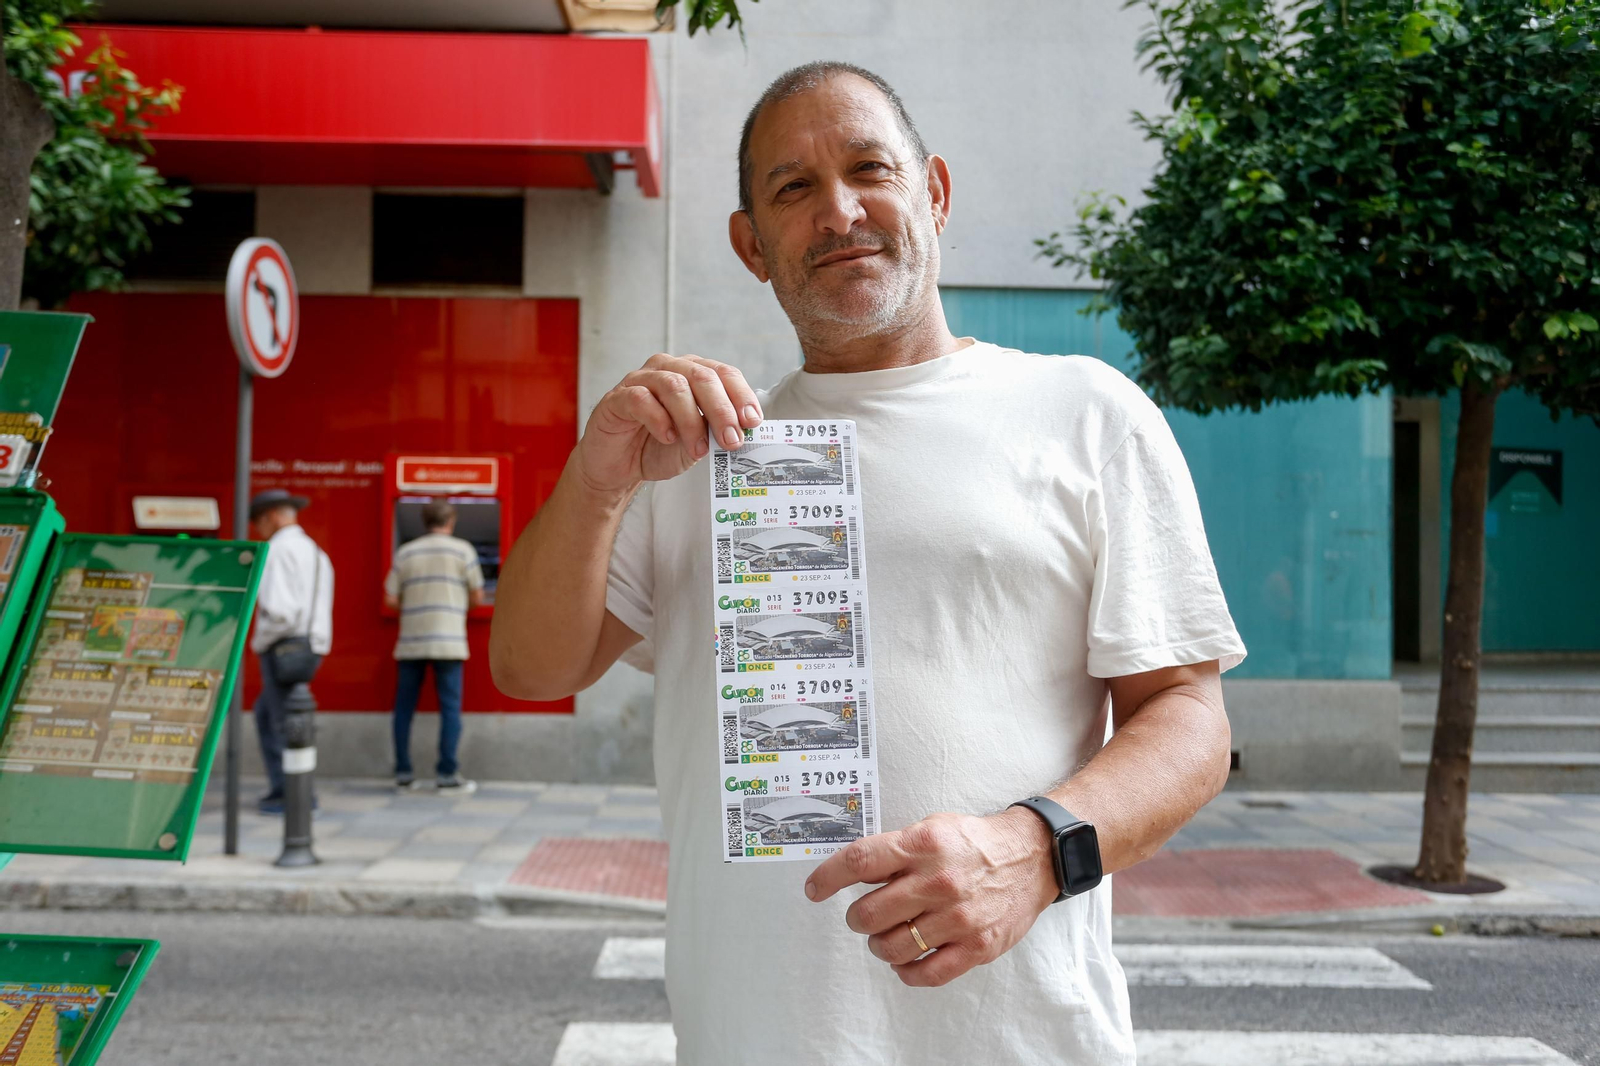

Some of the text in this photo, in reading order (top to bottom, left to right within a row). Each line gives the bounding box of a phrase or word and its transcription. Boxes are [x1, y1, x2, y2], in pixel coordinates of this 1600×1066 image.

[784, 424, 838, 438] 37095
[715, 508, 757, 524] CUPÓN
[789, 505, 844, 519] 37095
[718, 595, 761, 610] CUPÓN
[793, 590, 849, 606] 37095
[721, 684, 764, 700] CUPÓN
[797, 679, 854, 694] 37095
[725, 776, 768, 792] CUPÓN
[802, 770, 858, 786] 37095
